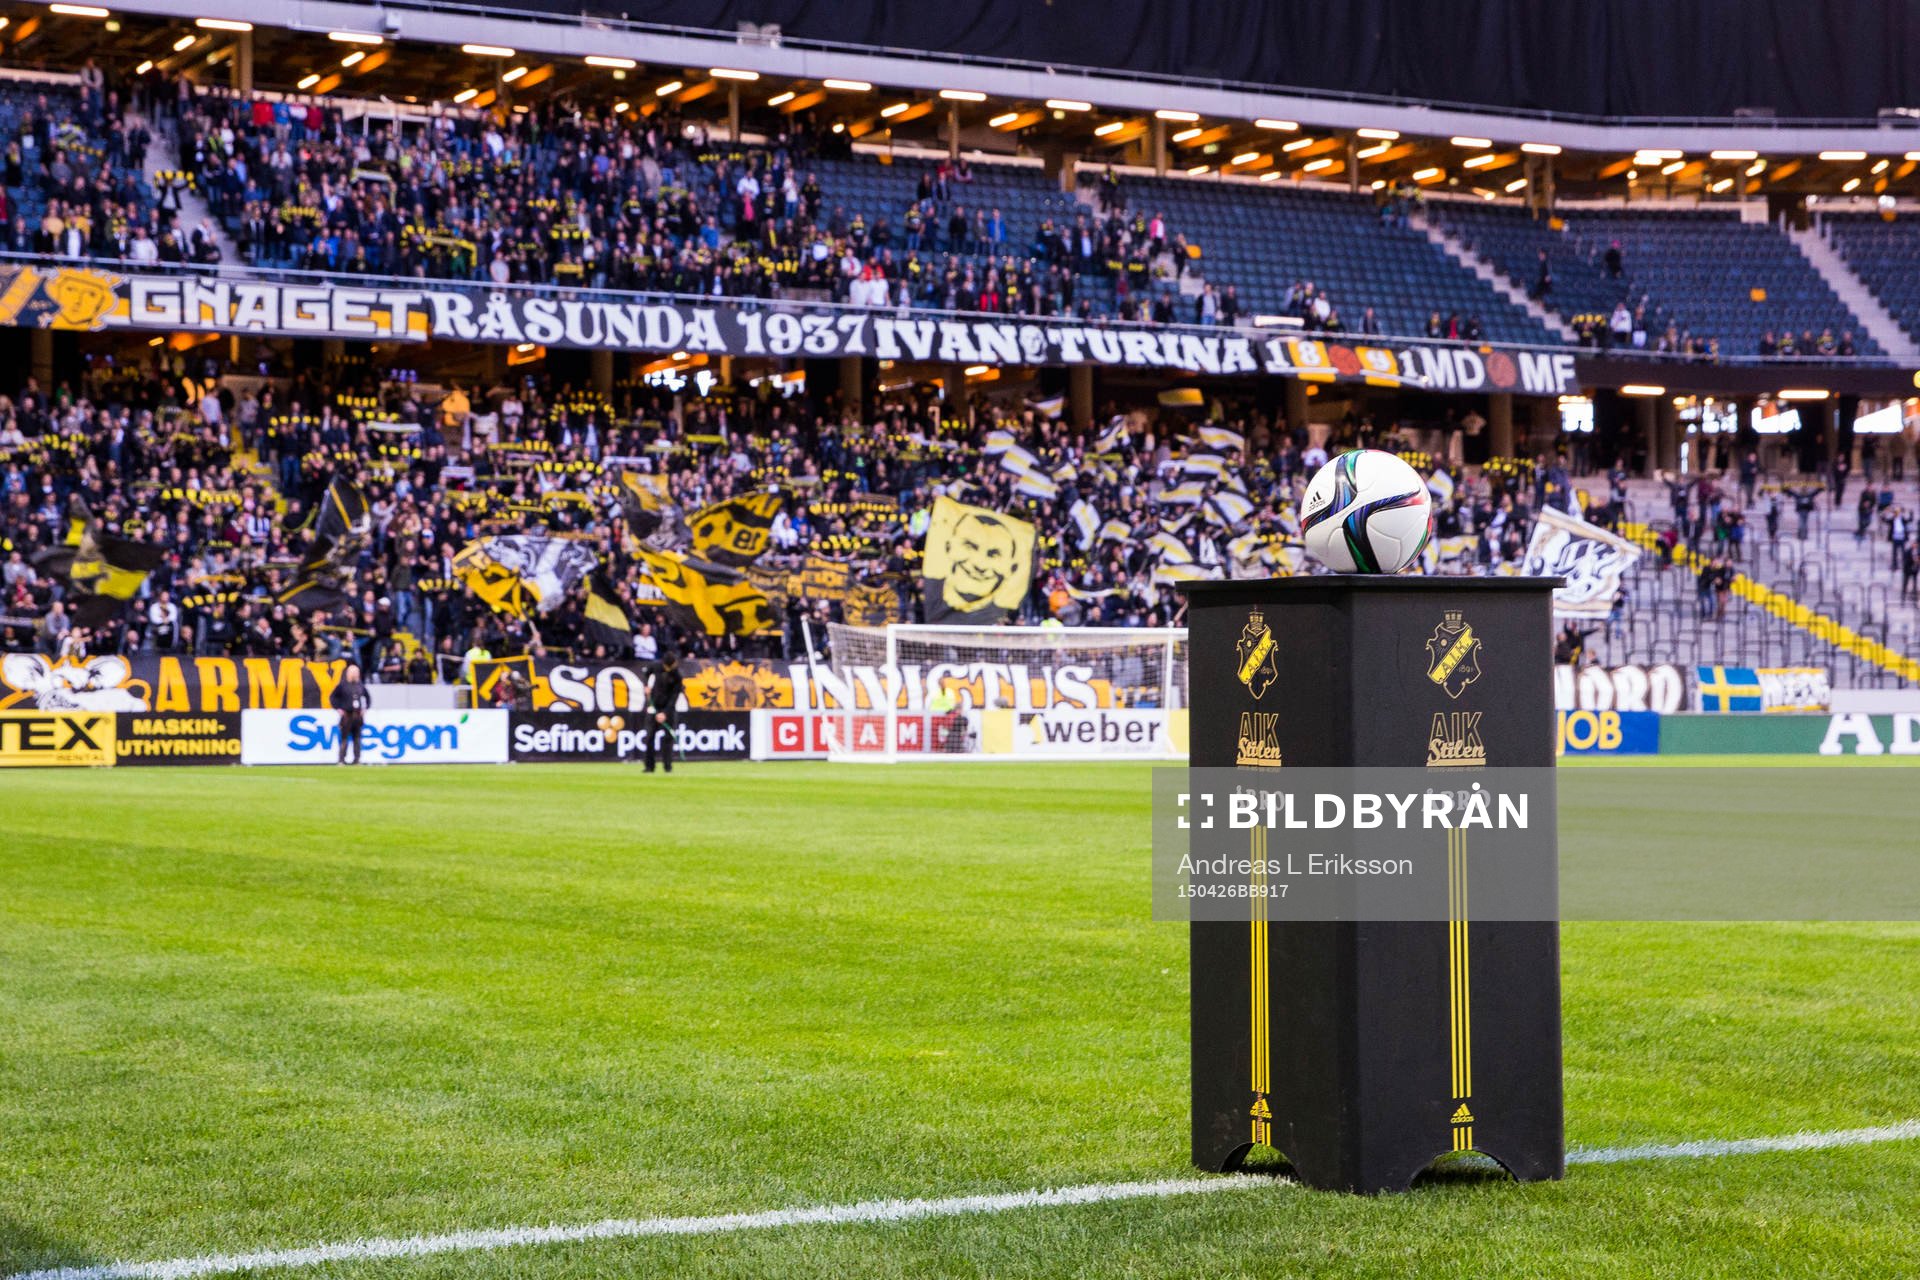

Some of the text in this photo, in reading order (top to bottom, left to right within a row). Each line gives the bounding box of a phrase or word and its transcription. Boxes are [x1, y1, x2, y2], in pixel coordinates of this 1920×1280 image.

[427, 291, 868, 355] RÅSUNDA 1937
[874, 317, 1257, 374] IVAN TURINA
[1518, 351, 1576, 394] MF
[156, 656, 346, 713] ARMY
[549, 661, 1098, 712] SO INVICTUS
[133, 719, 227, 735] MASKIN-
[514, 723, 604, 752] Sefina
[778, 720, 950, 747] CRAM
[1044, 713, 1161, 743] weber
[1429, 711, 1483, 750] AIK
[117, 739, 242, 756] UTHYRNING
[1427, 738, 1487, 763] Stilen
[1451, 1116, 1475, 1124] adidas
